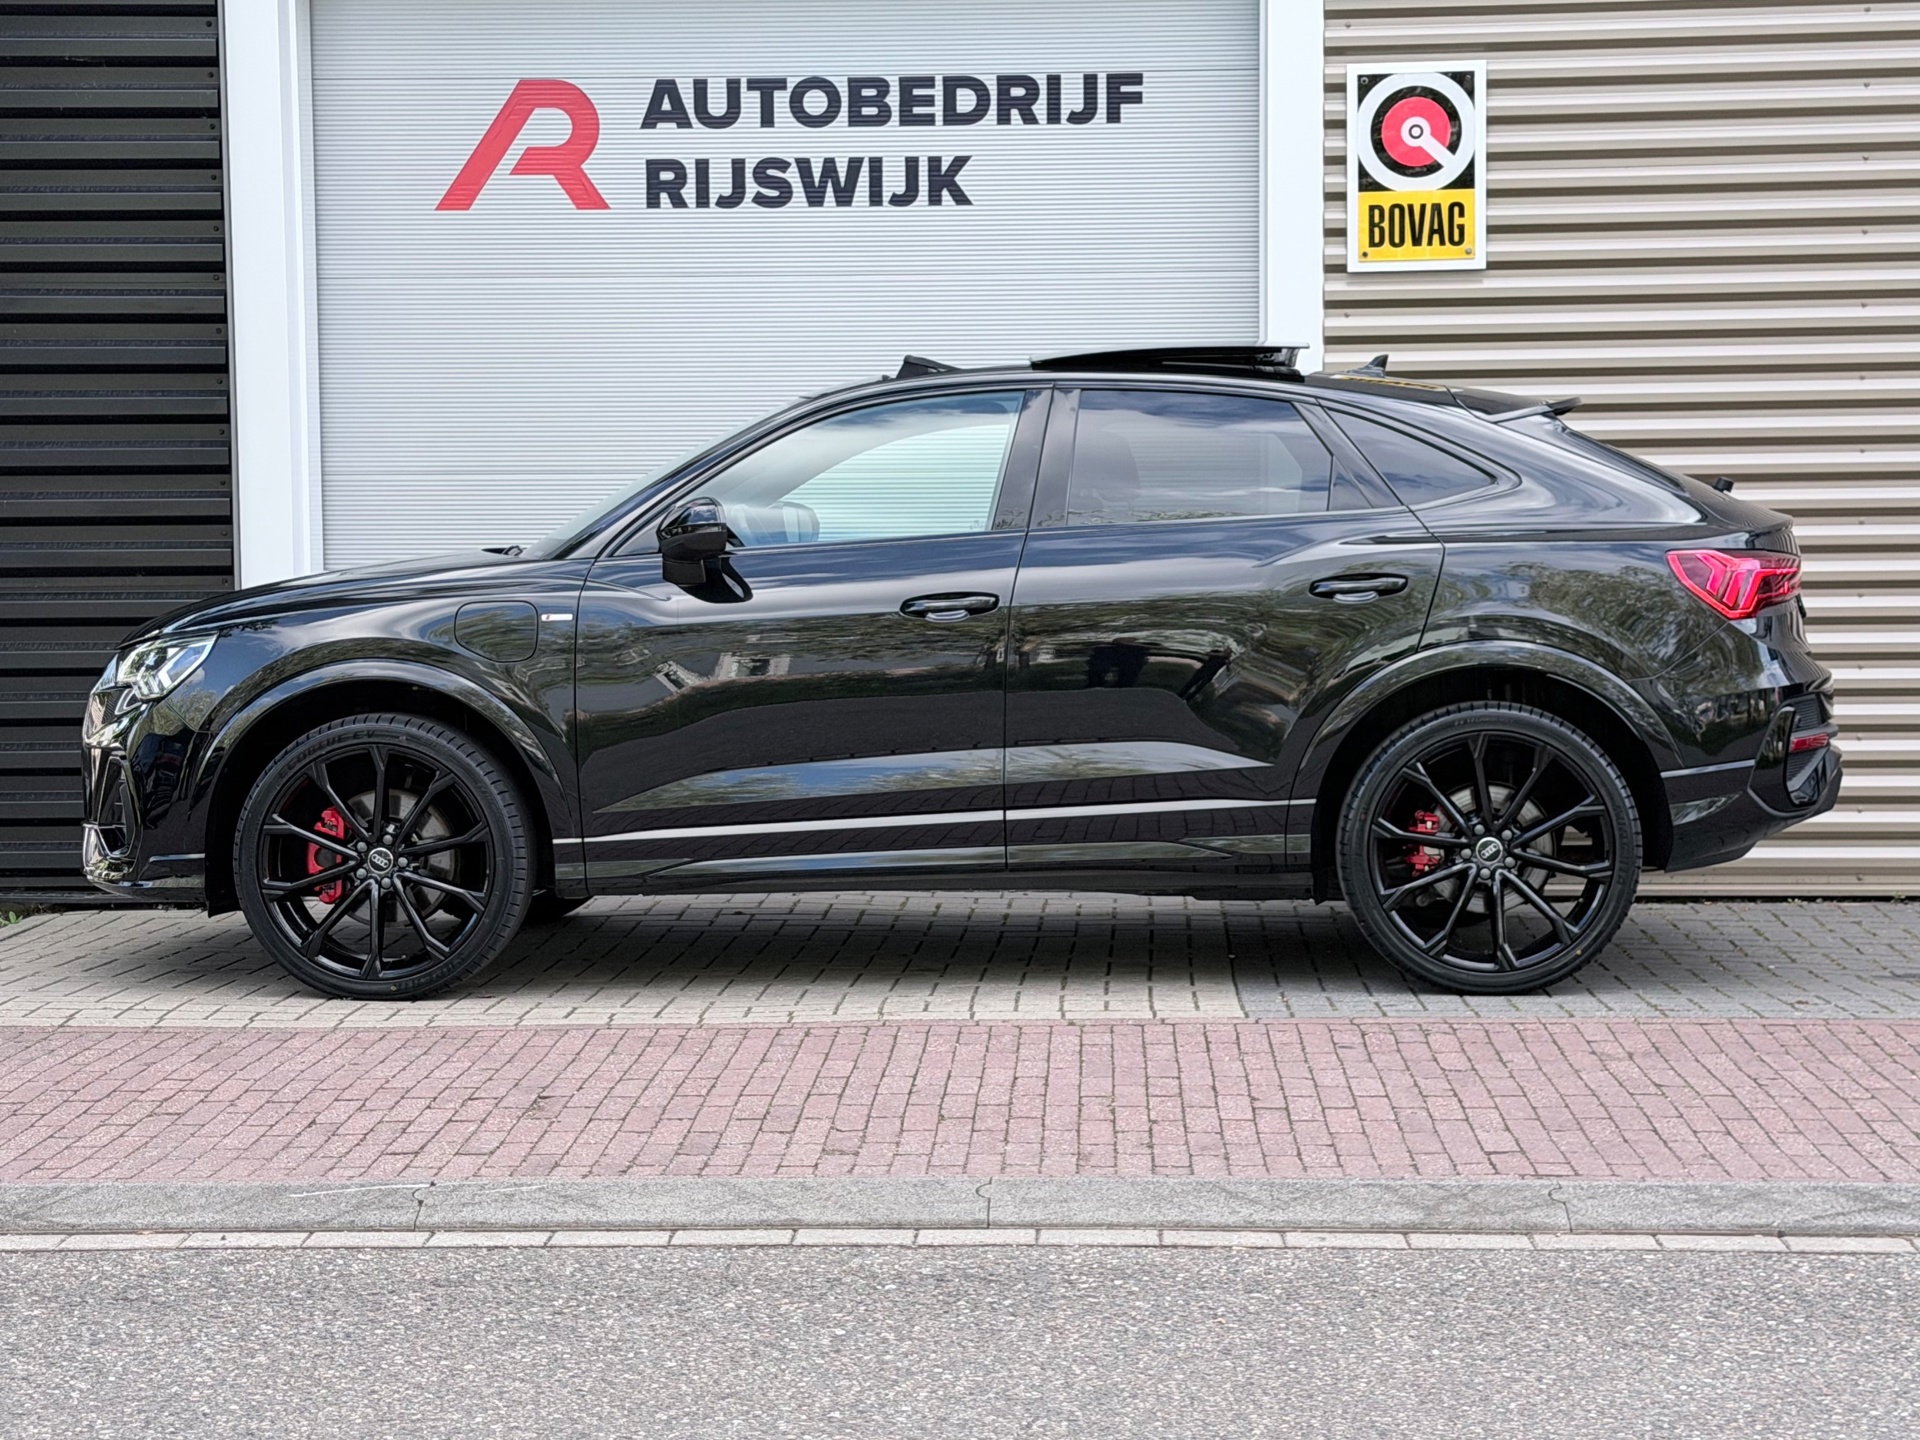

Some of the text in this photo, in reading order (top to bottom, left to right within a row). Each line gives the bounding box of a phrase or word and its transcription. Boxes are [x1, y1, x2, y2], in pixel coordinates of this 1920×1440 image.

[640, 73, 1144, 129] AUTOBEDRIJF
[645, 155, 973, 209] RIJSWIJK
[1368, 201, 1466, 249] BOVAG
